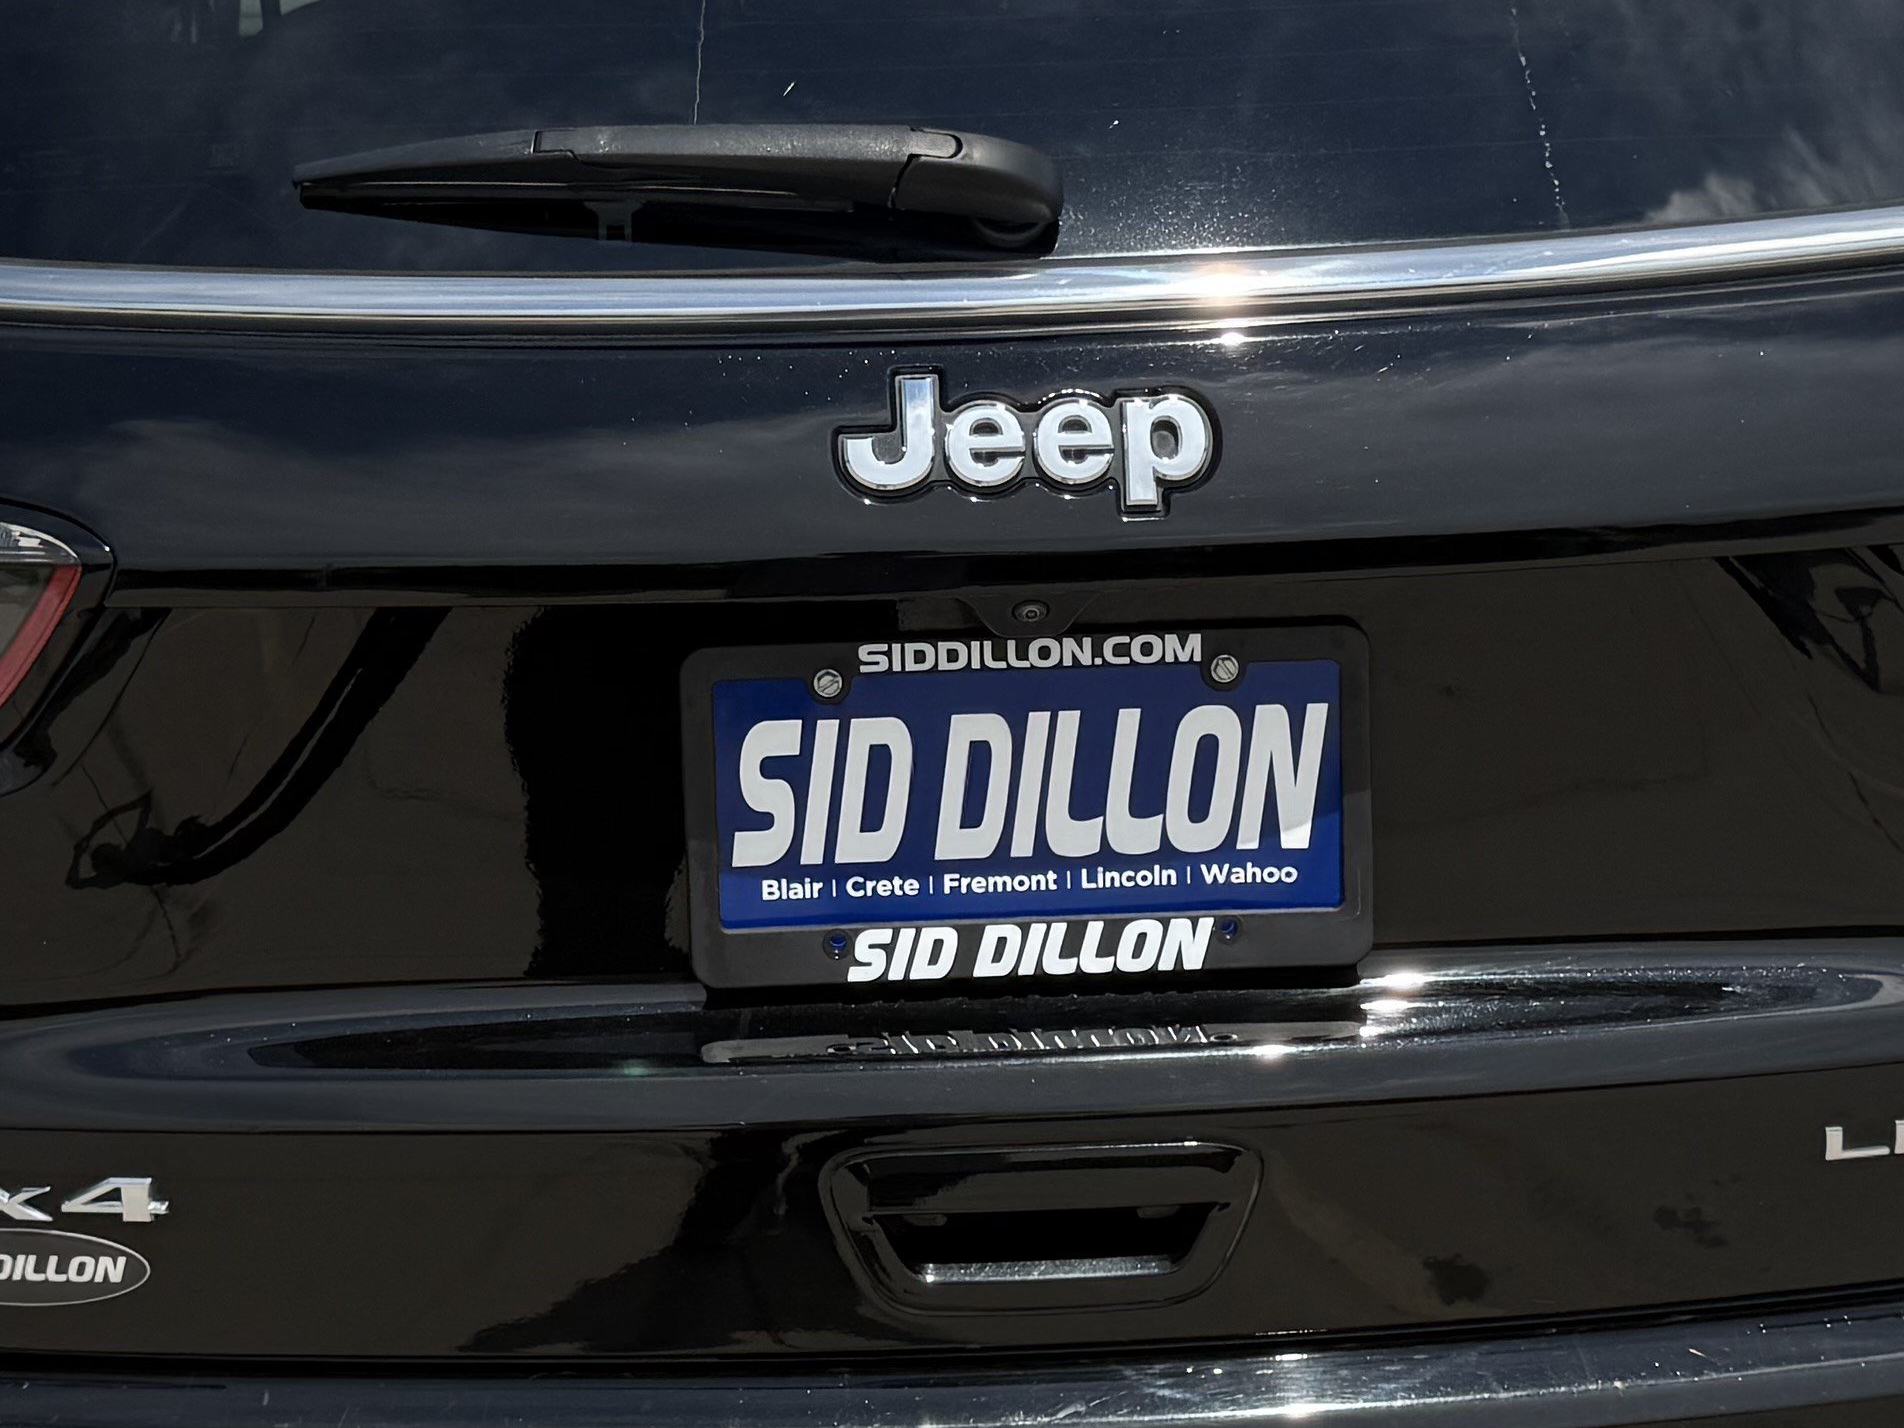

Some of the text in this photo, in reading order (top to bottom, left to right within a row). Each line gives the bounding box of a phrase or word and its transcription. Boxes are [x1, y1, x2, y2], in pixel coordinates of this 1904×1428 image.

[838, 372, 1212, 508] Jeep
[857, 633, 1202, 674] SIDDILLON.COM
[730, 701, 1330, 869] SID DILLON
[761, 861, 1298, 901] Blair Crete Fremont Lincoln Wahoo
[845, 915, 1216, 984] SID DILLON
